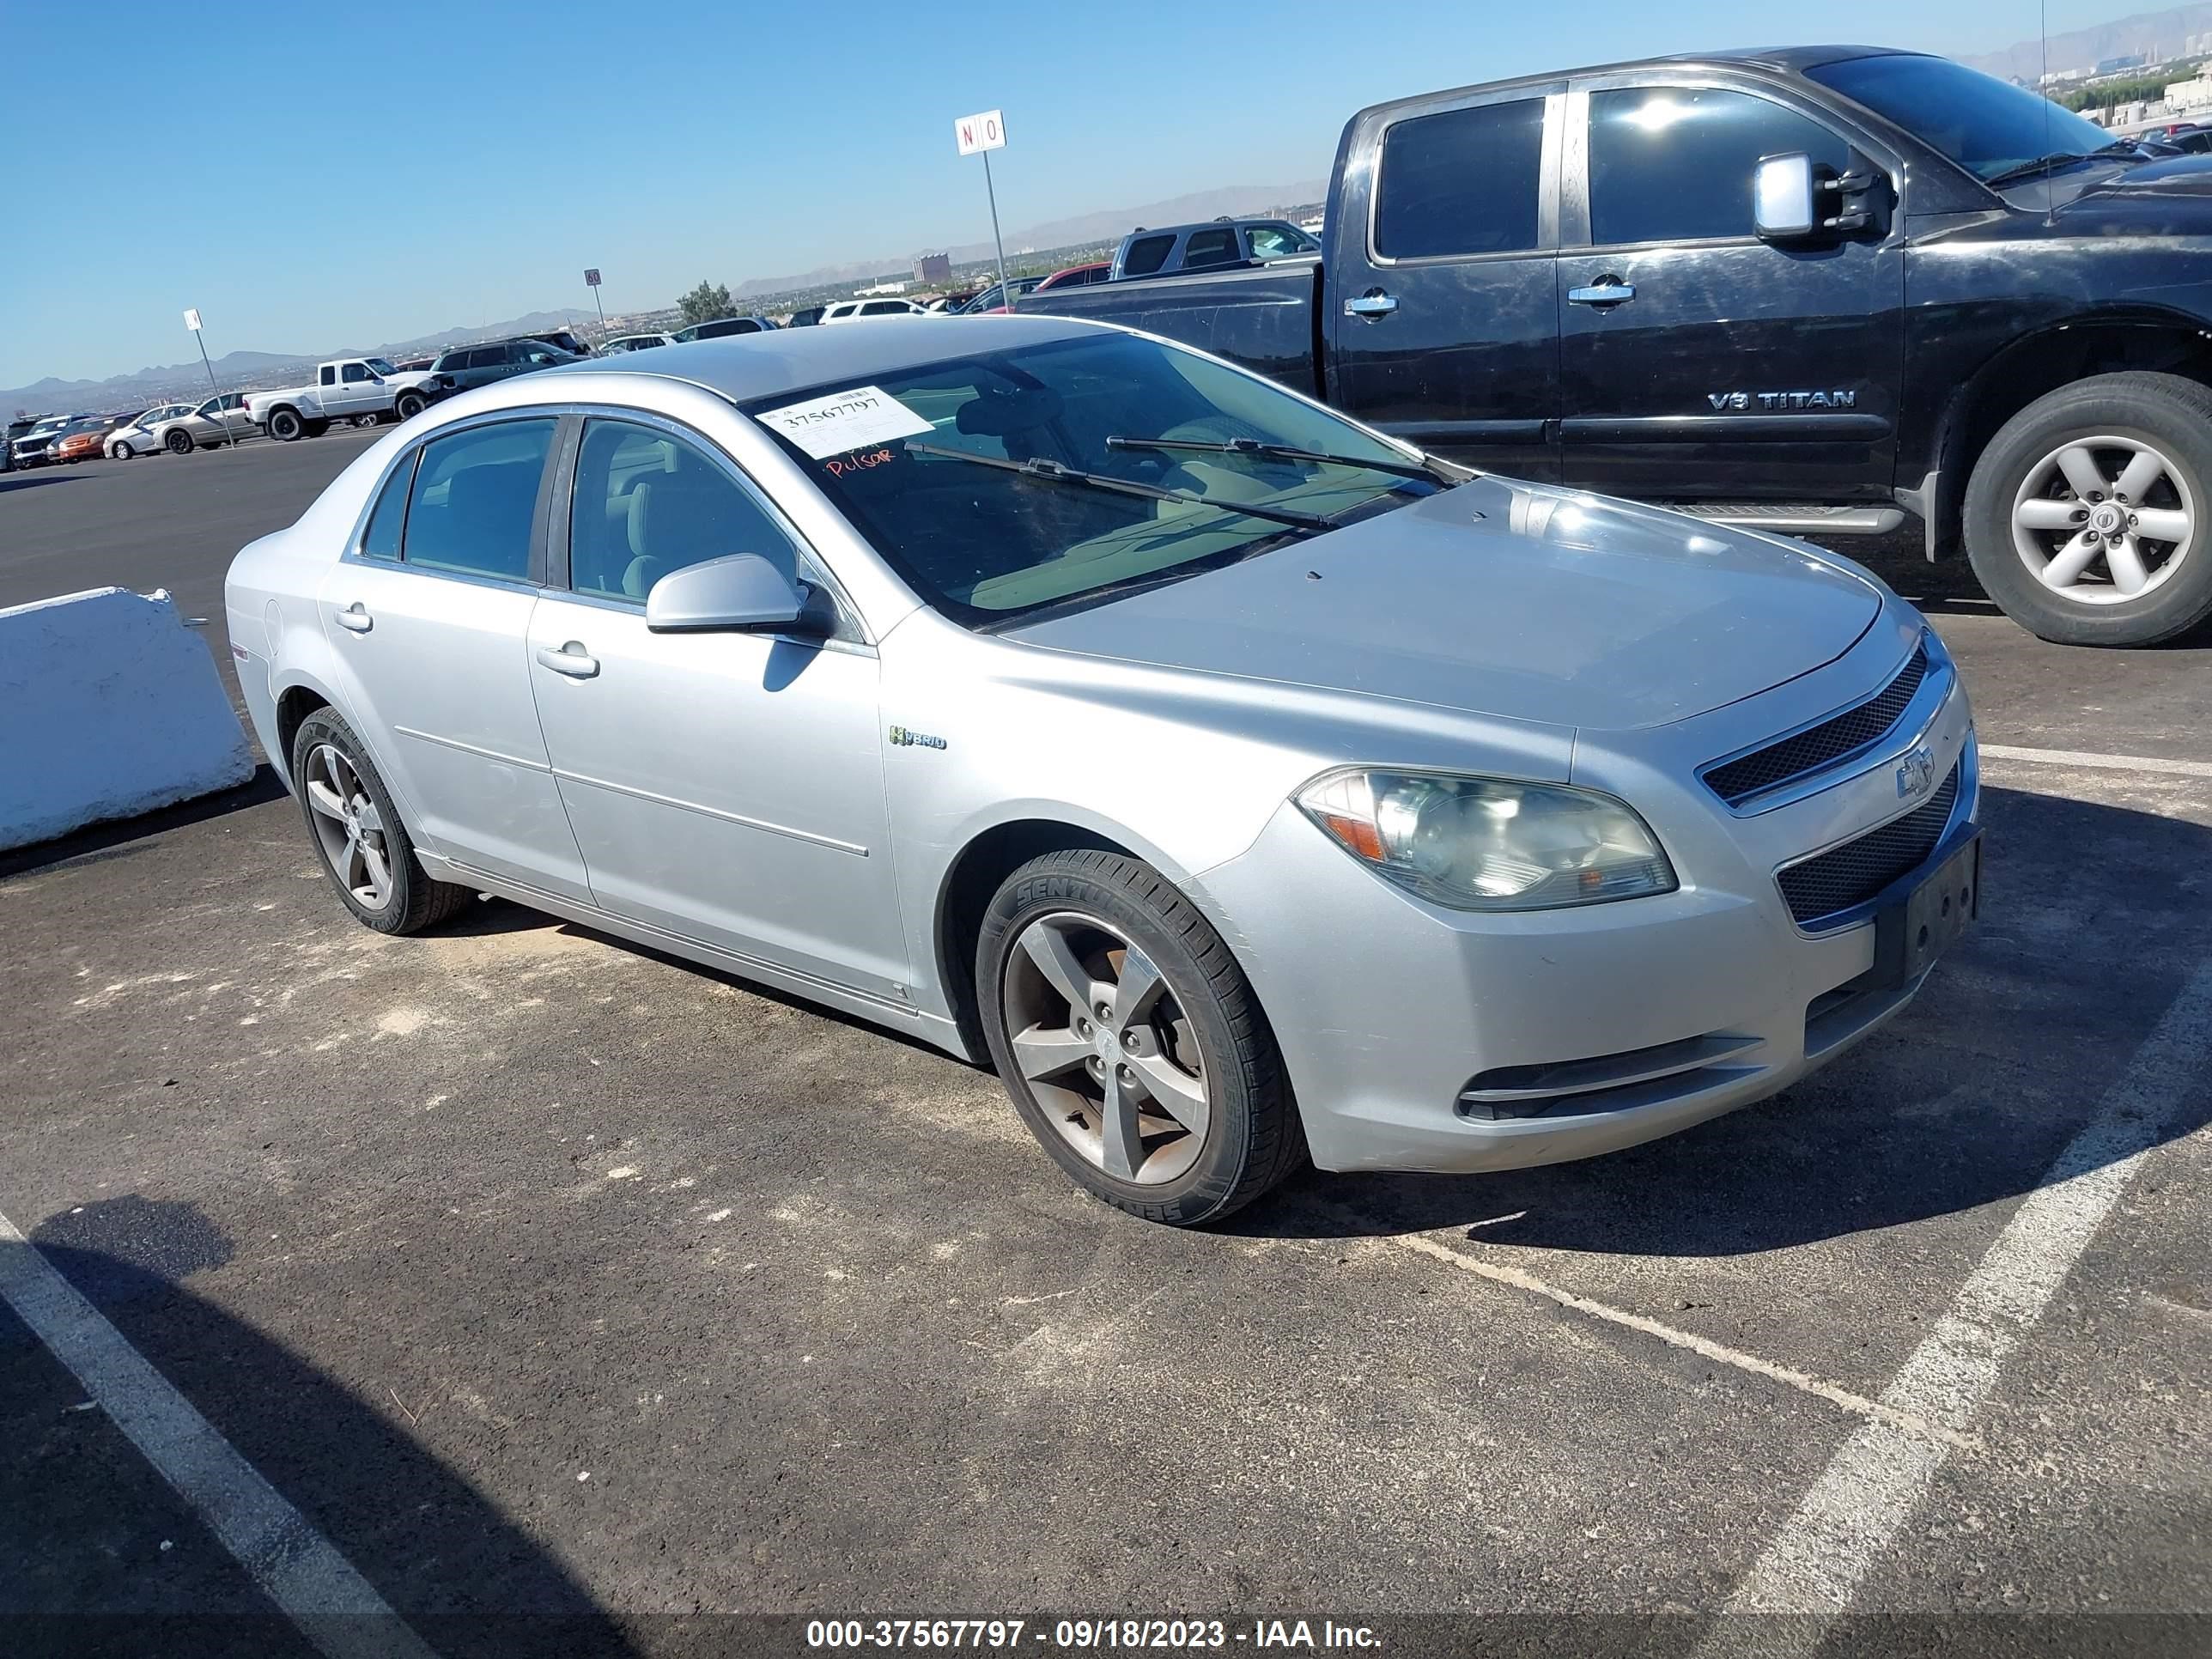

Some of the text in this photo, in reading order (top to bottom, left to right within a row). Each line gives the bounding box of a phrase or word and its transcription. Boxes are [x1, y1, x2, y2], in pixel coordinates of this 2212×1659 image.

[1707, 391, 1856, 410] V8 TITAN
[783, 398, 880, 429] 37567797
